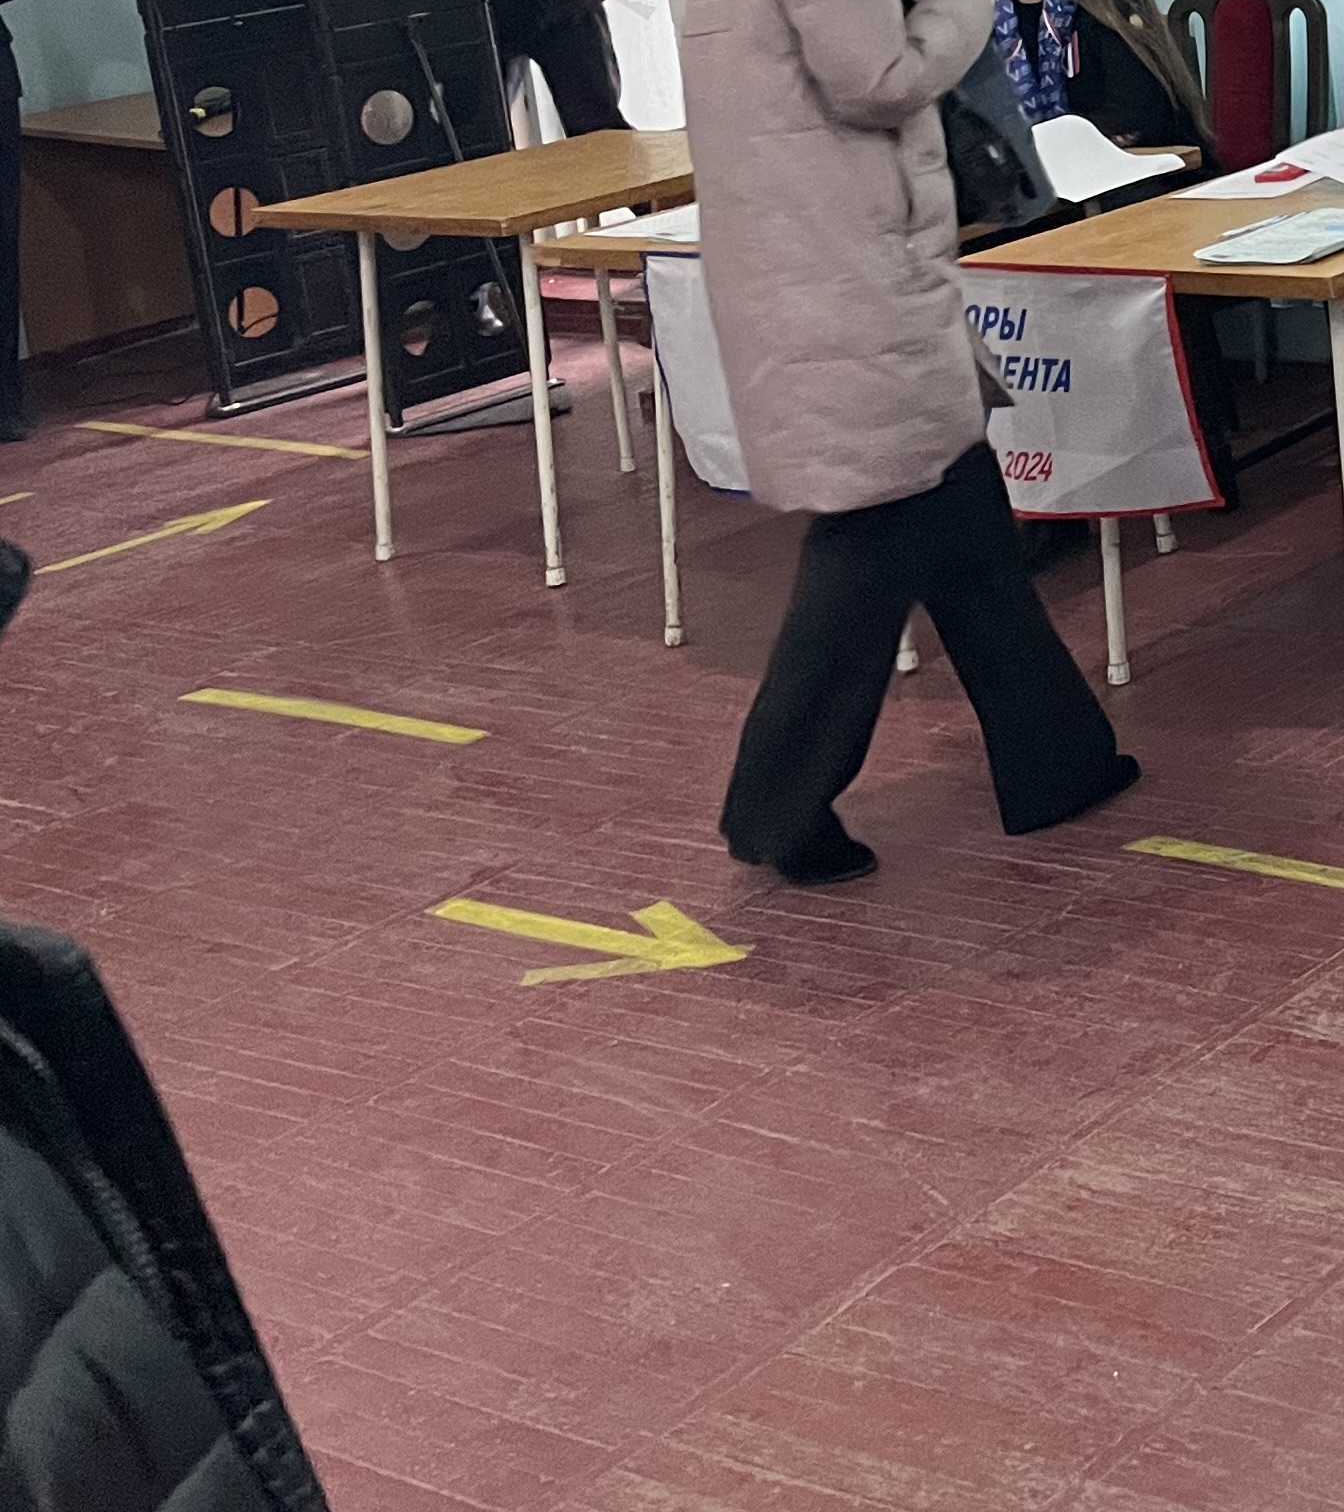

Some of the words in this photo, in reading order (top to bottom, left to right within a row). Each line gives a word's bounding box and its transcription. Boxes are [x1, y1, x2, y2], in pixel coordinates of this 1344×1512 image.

[965, 304, 1027, 341] ОРЫ
[1003, 355, 1071, 392] ЕНТА
[1005, 450, 1053, 482] 2024
